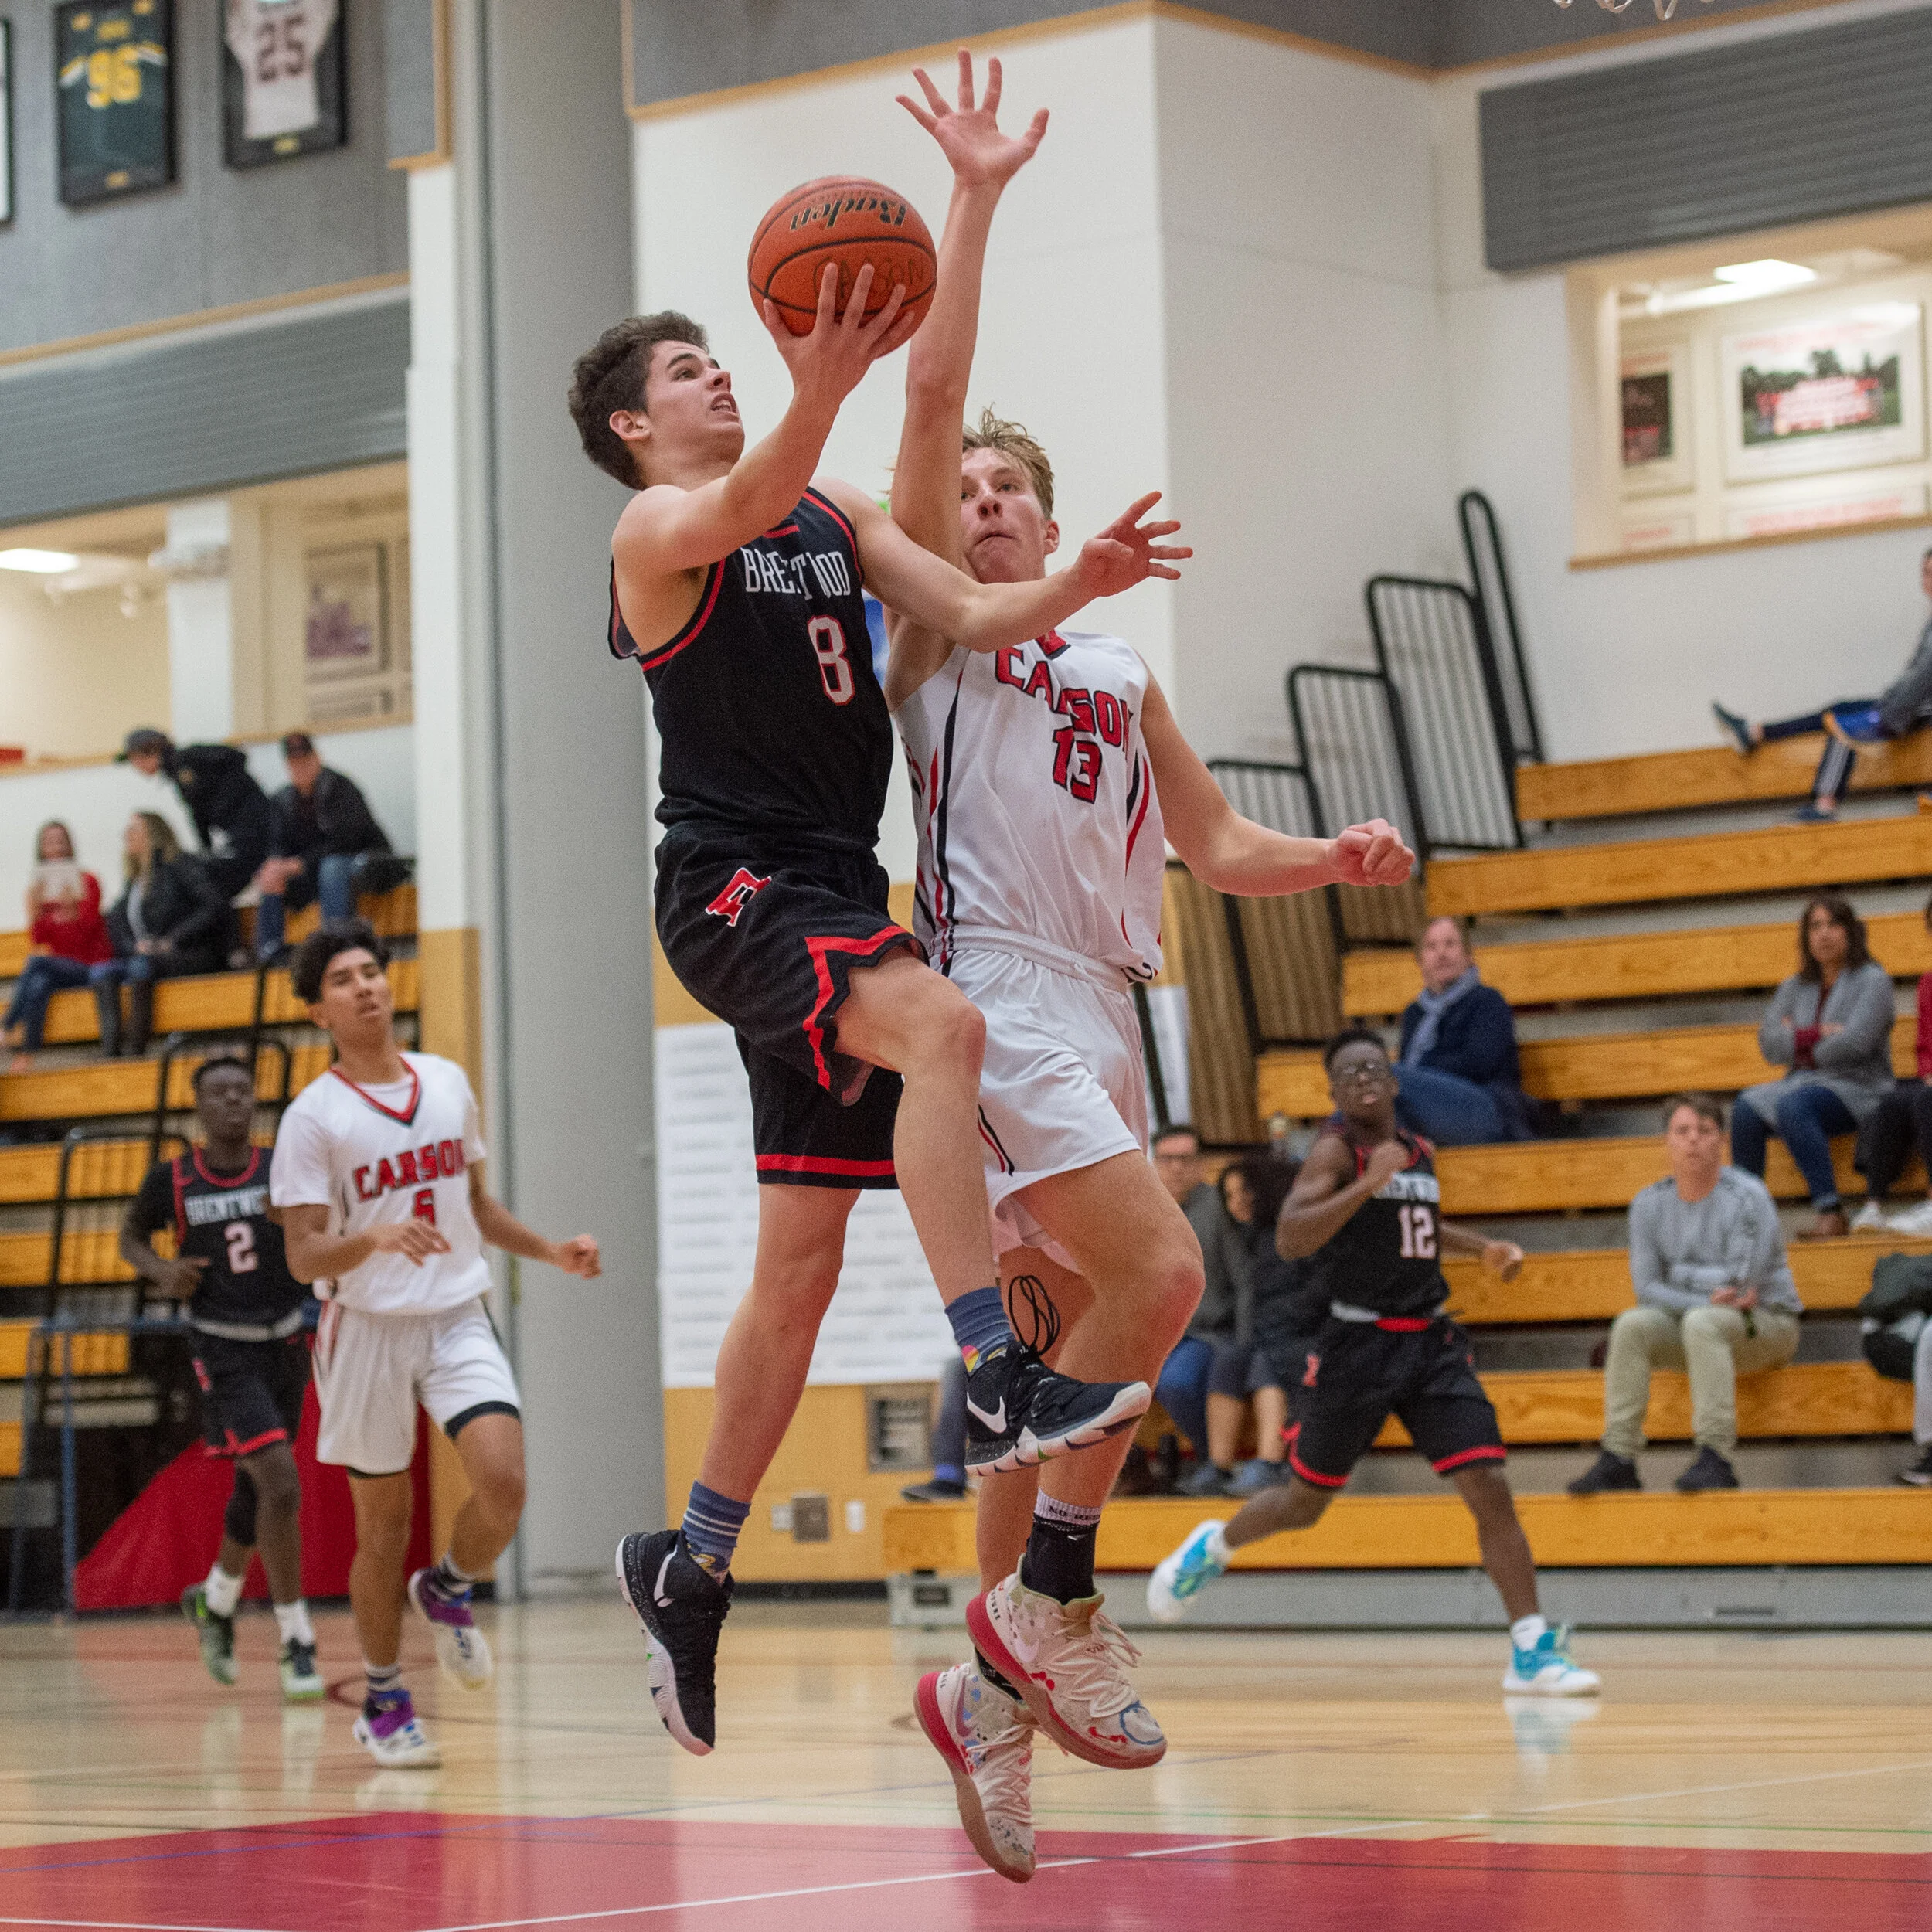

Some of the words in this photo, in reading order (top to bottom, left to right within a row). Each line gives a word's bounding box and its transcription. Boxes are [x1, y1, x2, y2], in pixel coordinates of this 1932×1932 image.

[256, 13, 305, 84] 25
[790, 198, 906, 230] Baden
[813, 256, 925, 300] CASON
[807, 614, 855, 706] 8
[1052, 726, 1103, 804] 13
[224, 1222, 260, 1274] 2
[1397, 1205, 1437, 1259] 12
